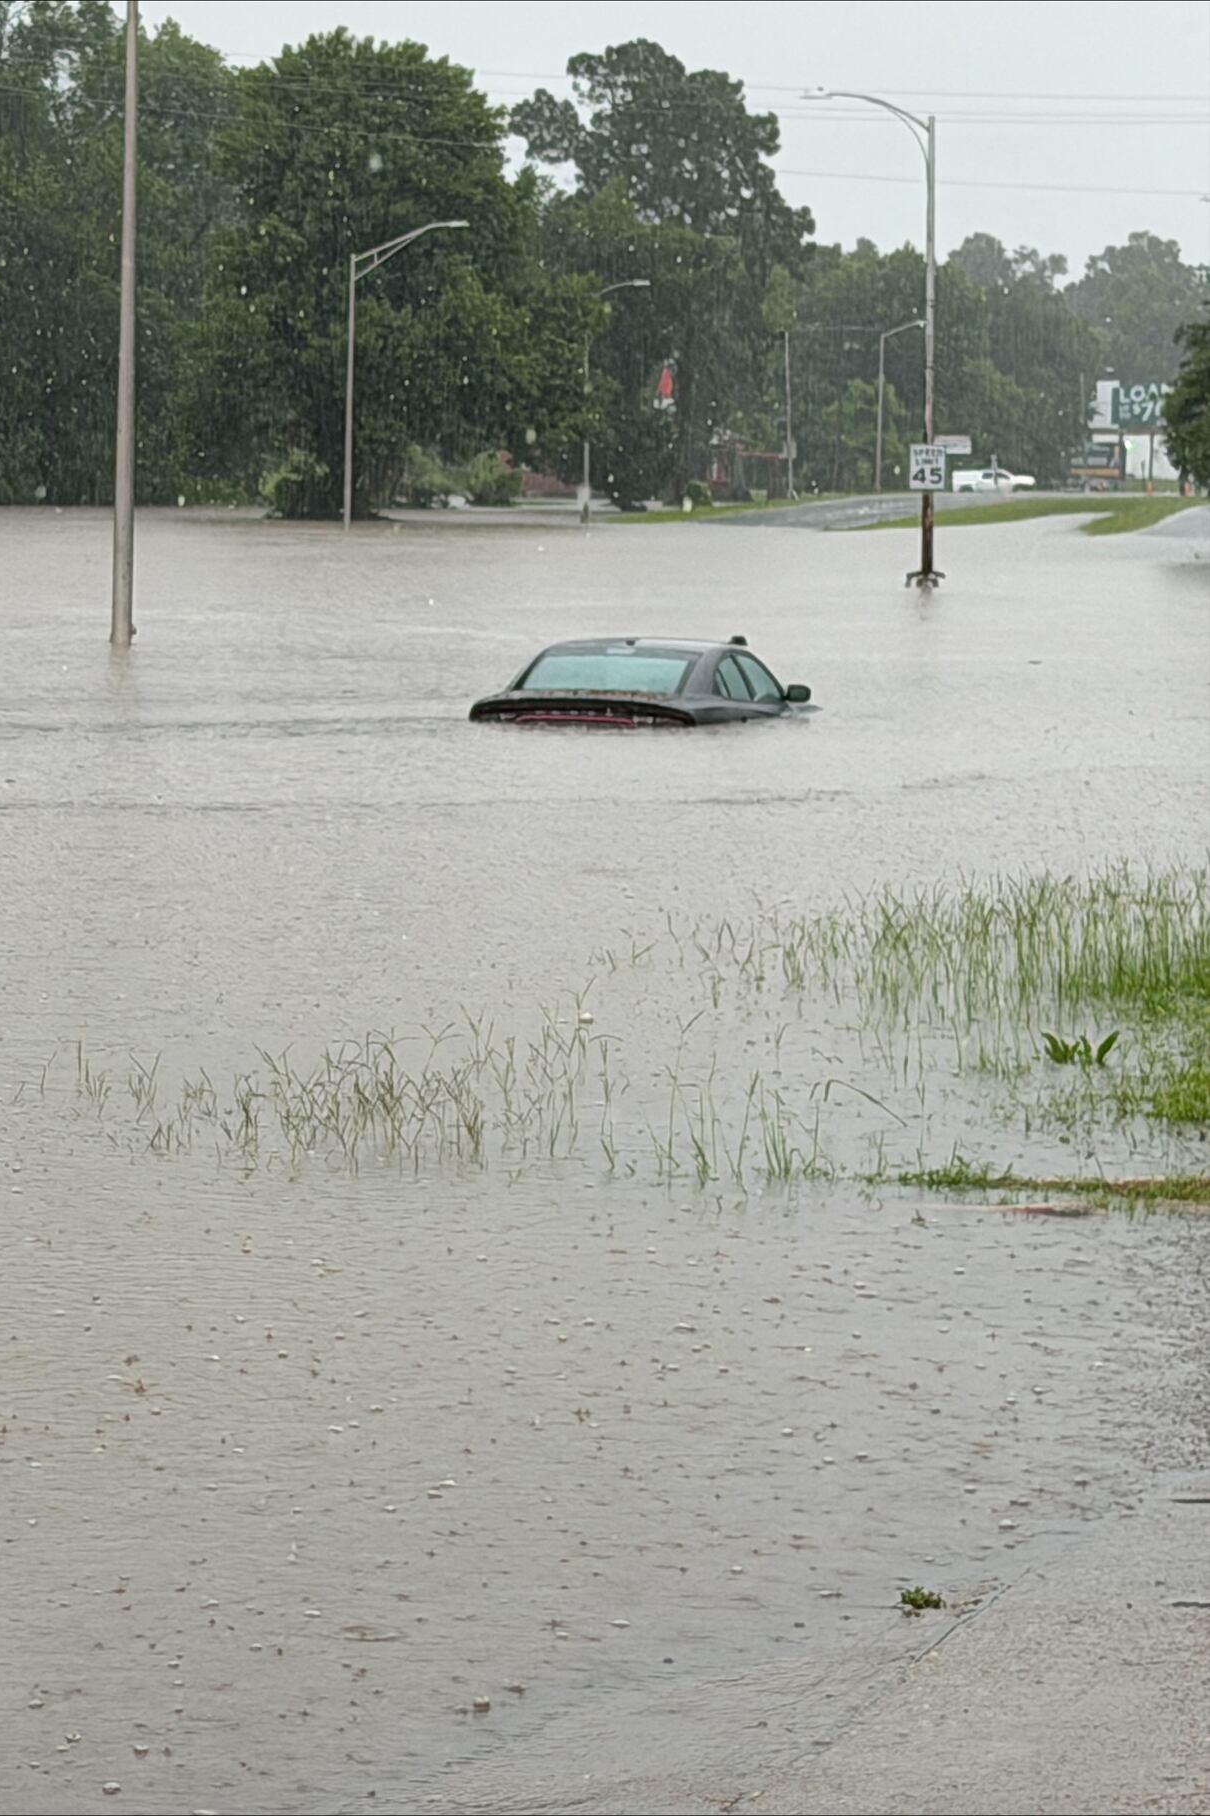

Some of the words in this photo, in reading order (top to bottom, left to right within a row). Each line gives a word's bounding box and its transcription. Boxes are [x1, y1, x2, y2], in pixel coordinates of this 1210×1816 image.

[913, 448, 943, 457] SPEED
[915, 457, 939, 467] LIMIT
[912, 467, 942, 485] 45
